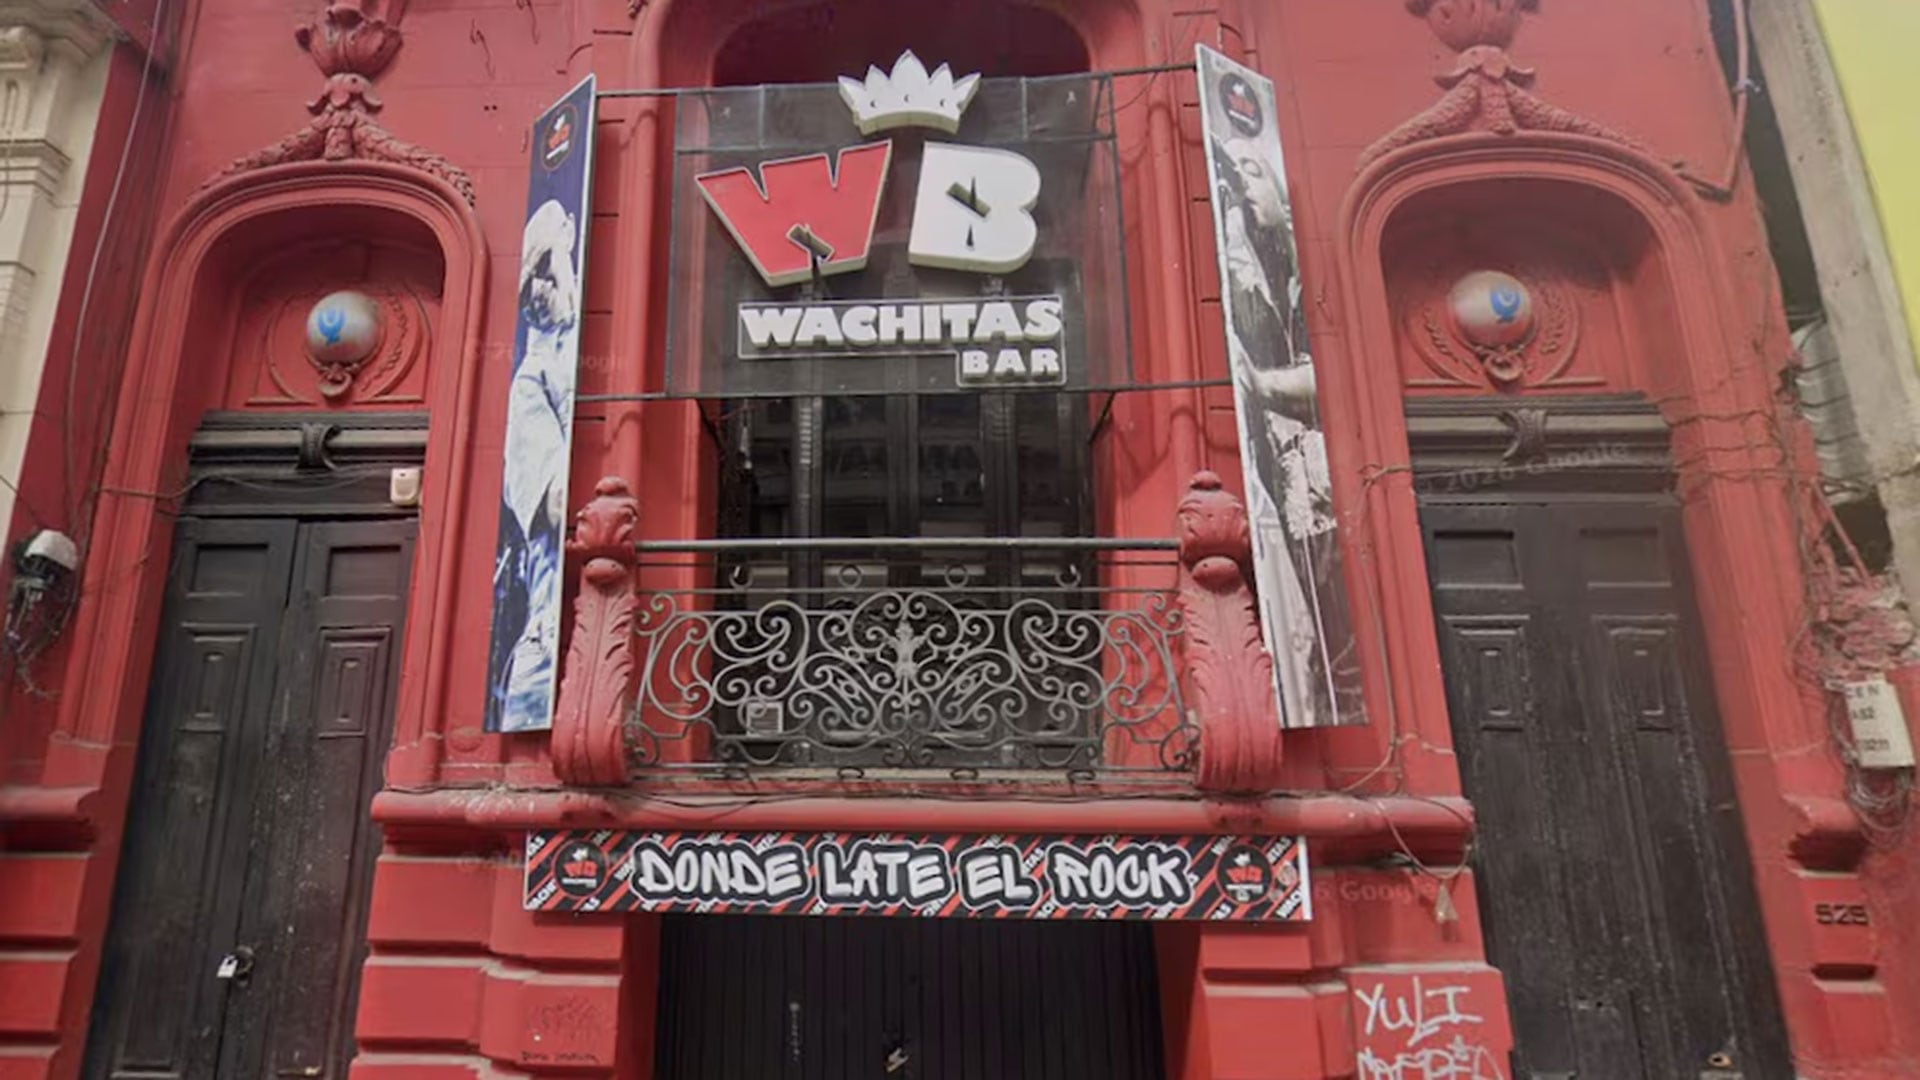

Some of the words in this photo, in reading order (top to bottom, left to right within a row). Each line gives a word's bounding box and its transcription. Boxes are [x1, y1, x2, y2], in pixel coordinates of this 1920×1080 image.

[740, 300, 1063, 349] WACHITAS
[962, 348, 1061, 378] BAR
[638, 847, 801, 895] DONDE
[824, 849, 945, 898] LATE
[966, 853, 1033, 900] EL
[1053, 852, 1184, 900] ROCK
[1354, 975, 1484, 1047] YULI
